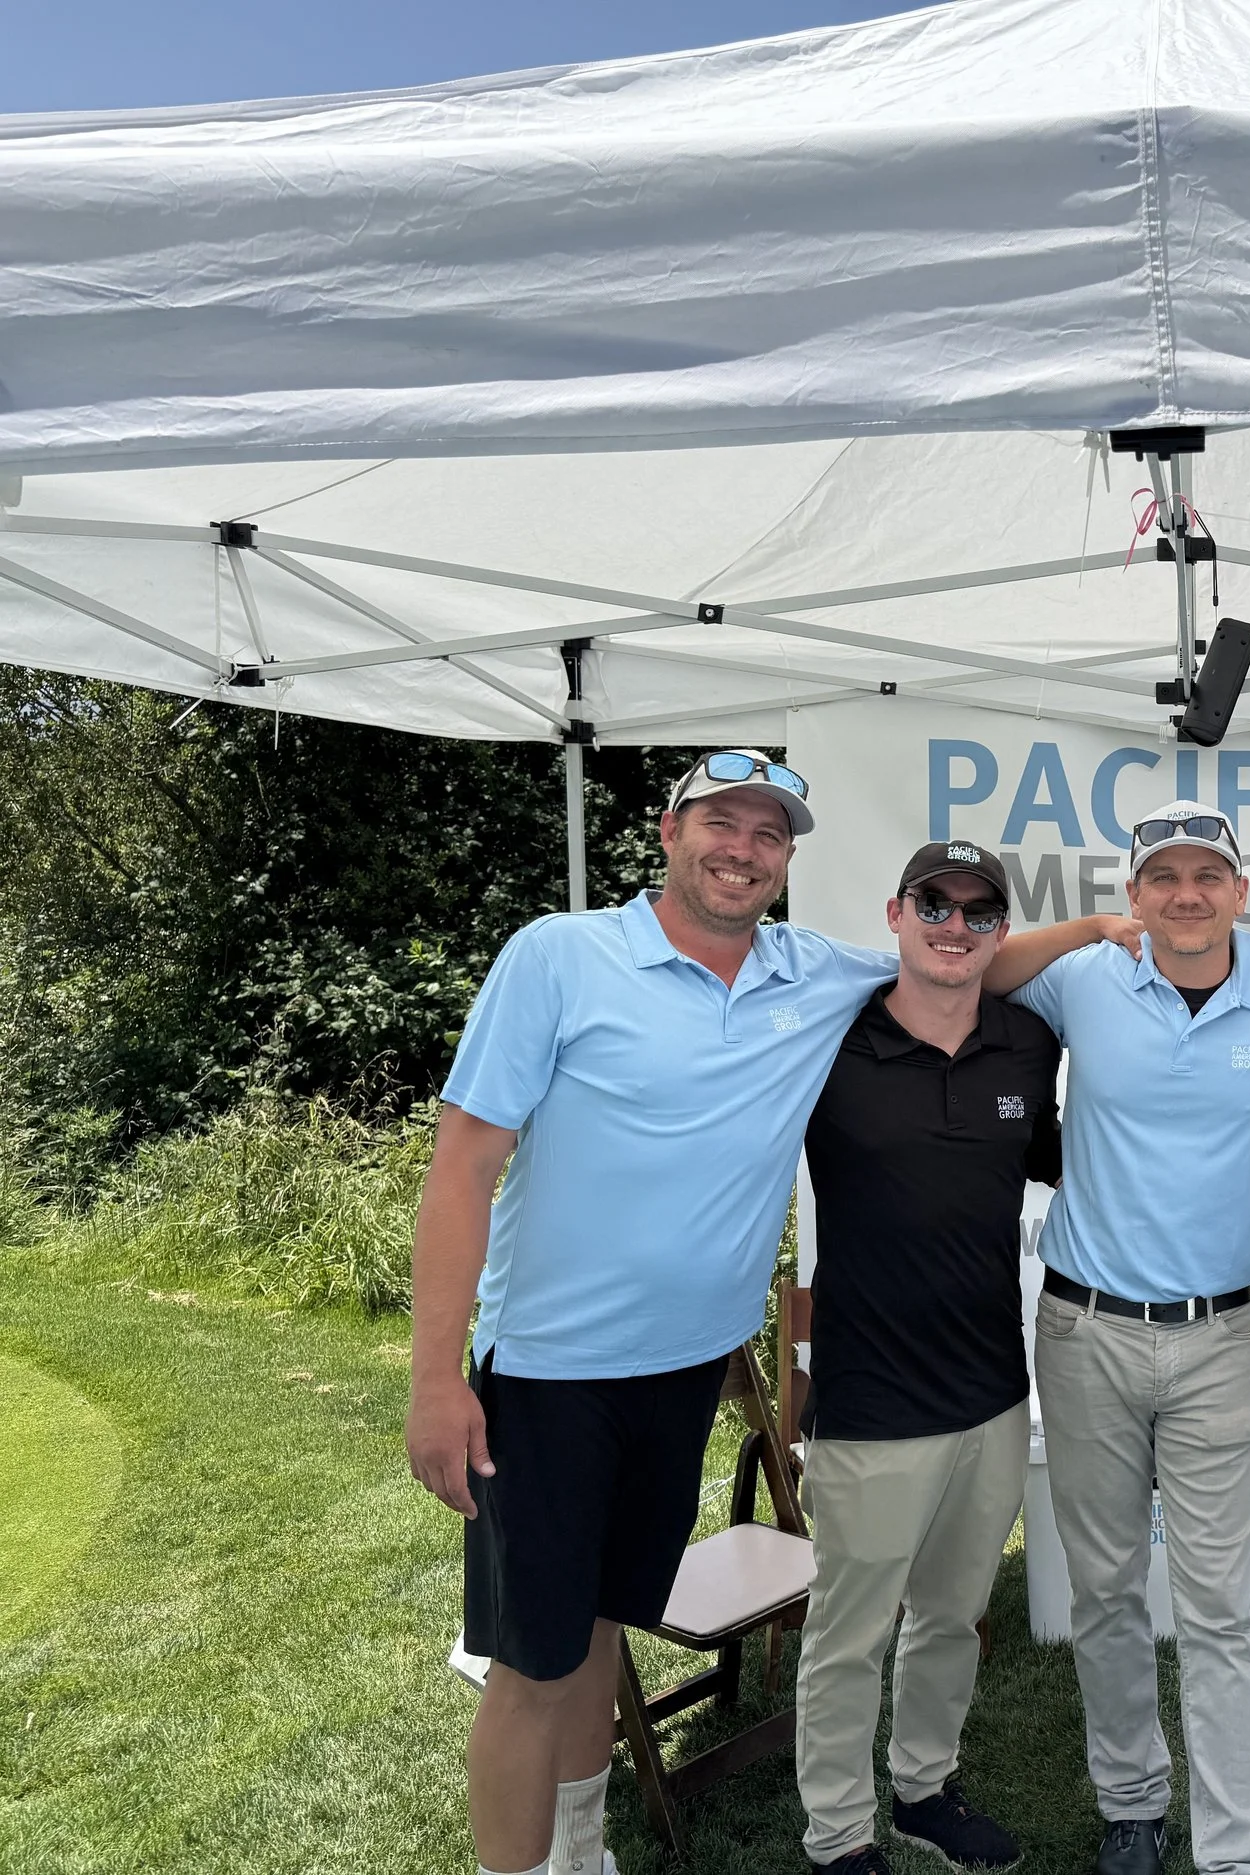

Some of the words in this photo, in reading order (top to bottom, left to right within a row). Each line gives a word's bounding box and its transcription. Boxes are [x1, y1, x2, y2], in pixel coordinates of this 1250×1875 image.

[948, 846, 980, 856] PACIFIC
[947, 854, 980, 863] GROUP
[769, 1006, 799, 1017] PACIFIC
[774, 1020, 801, 1031] GROUP
[997, 1096, 1024, 1104] PACIFIC
[999, 1110, 1024, 1119] GROUP
